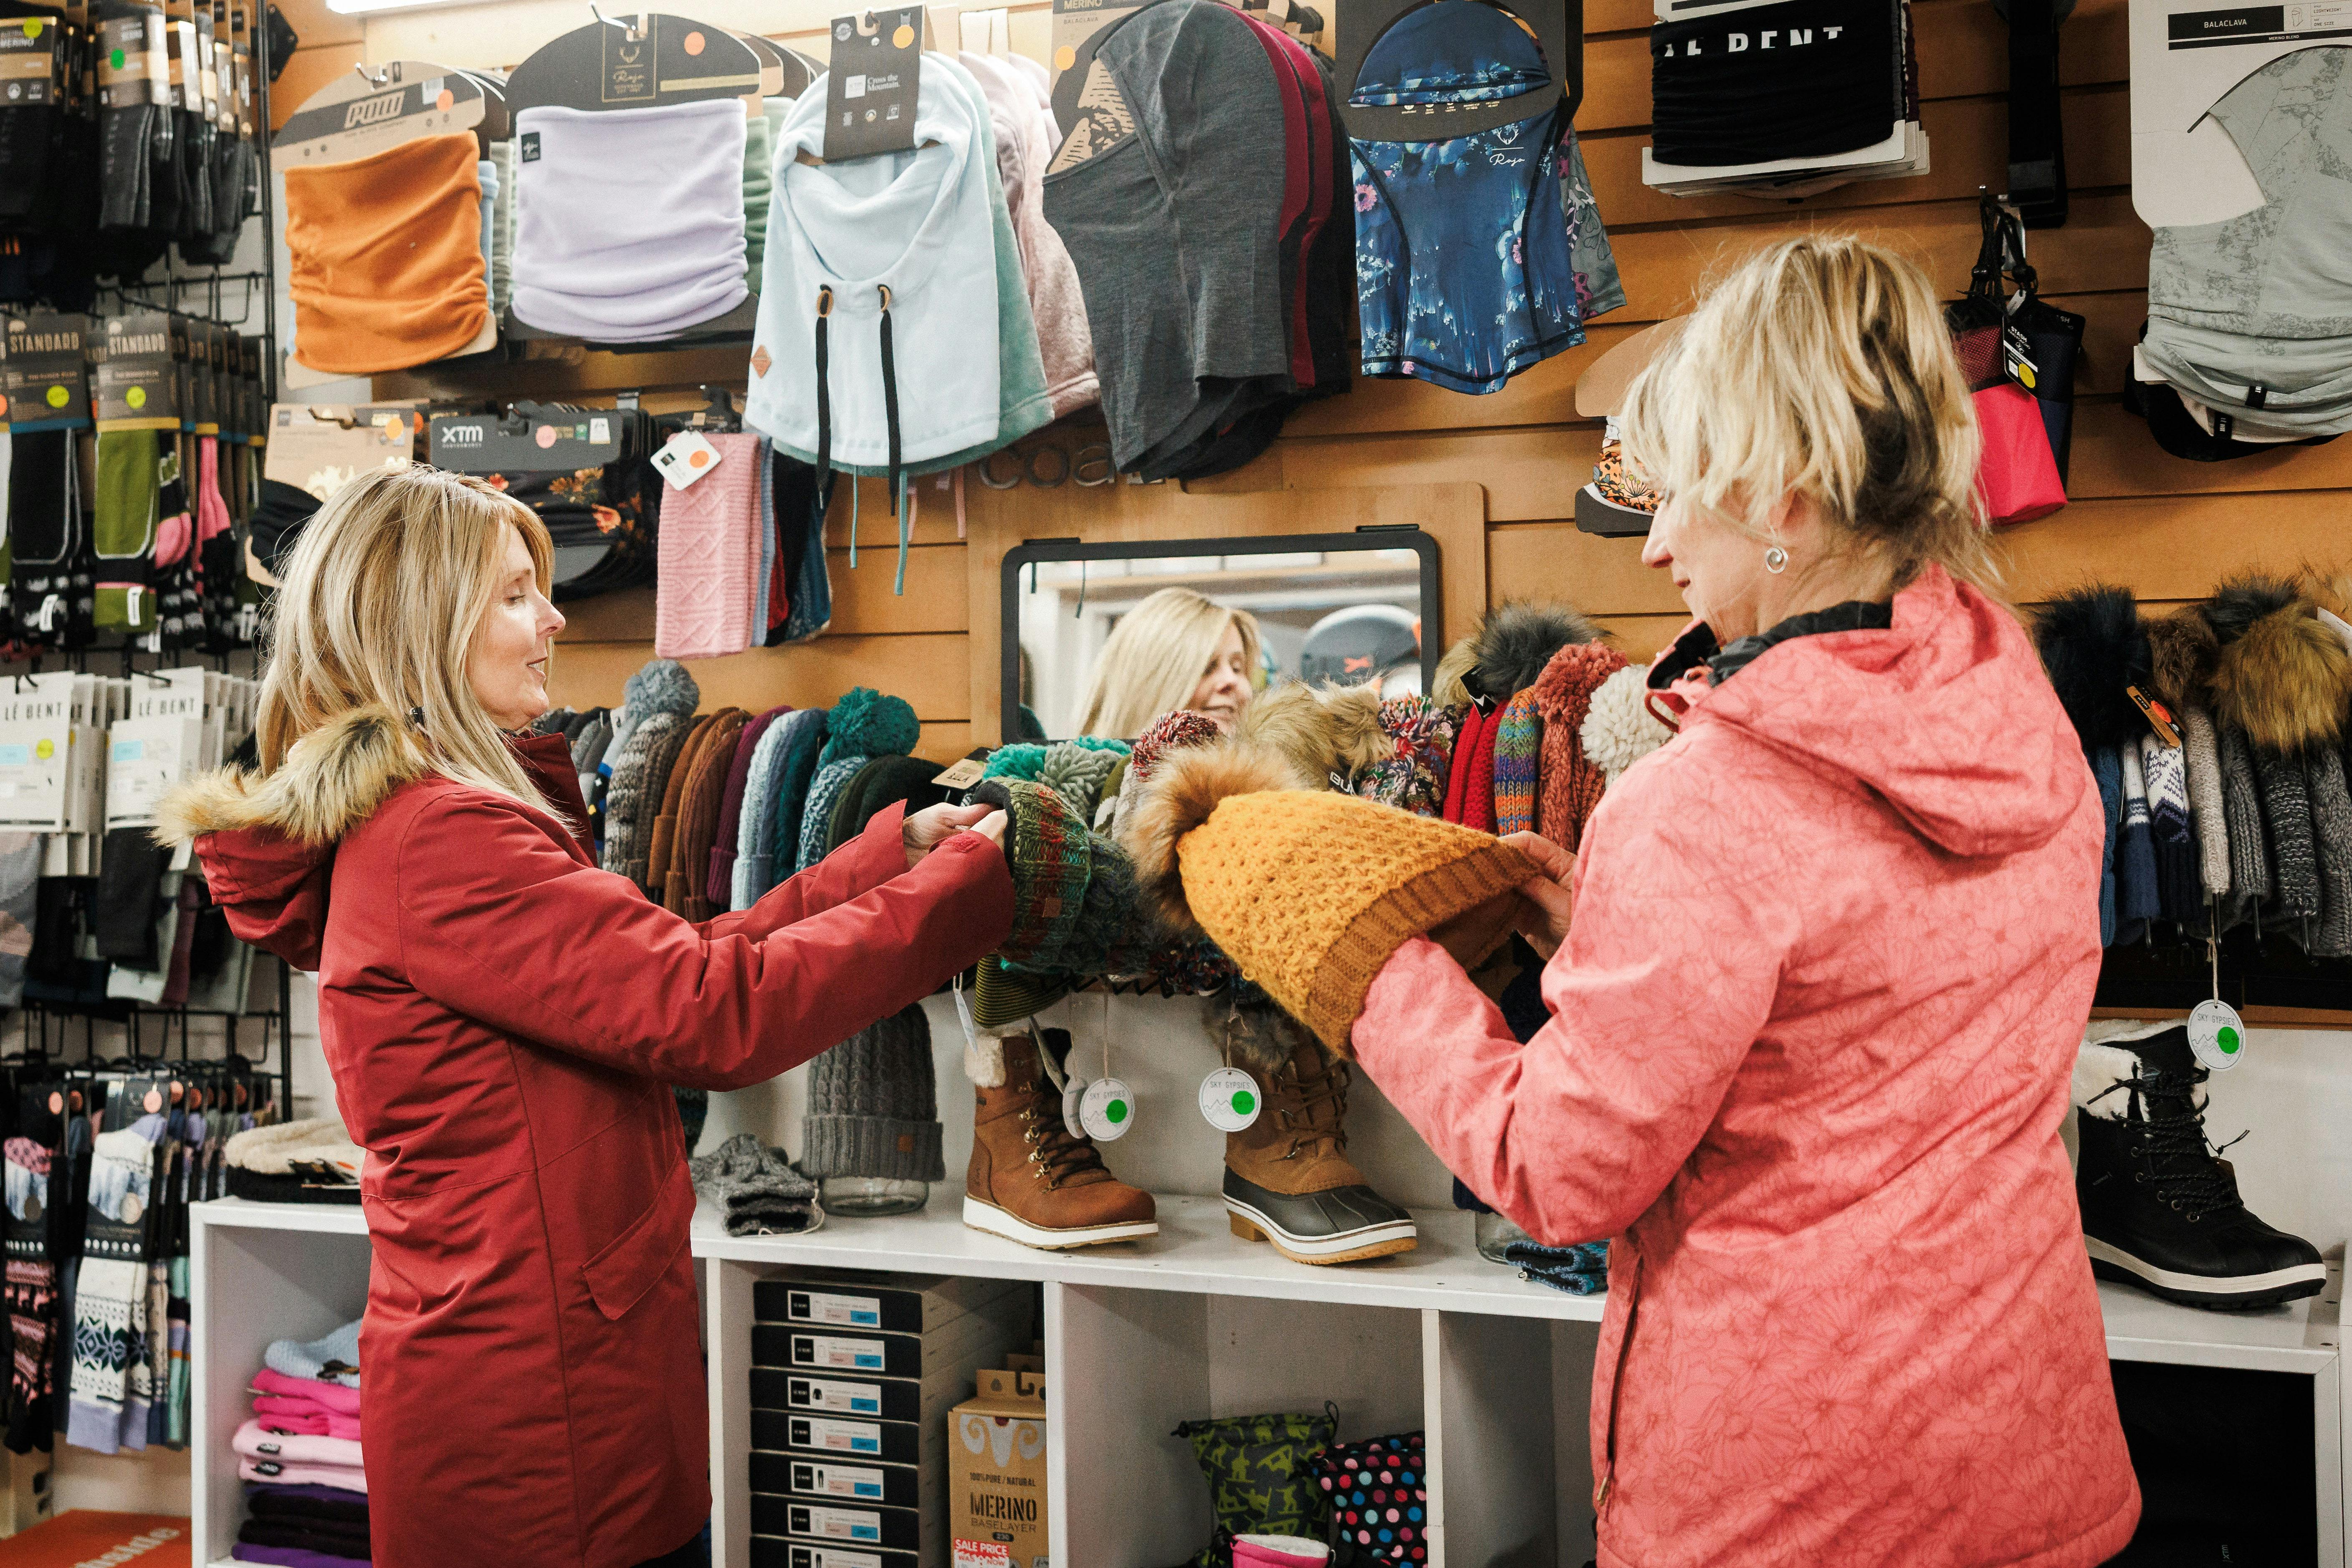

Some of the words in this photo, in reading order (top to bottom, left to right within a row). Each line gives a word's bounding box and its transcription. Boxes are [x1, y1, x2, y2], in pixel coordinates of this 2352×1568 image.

[2204, 19, 2247, 28] BALACLAVA
[2198, 1013, 2208, 1022] SKY
[2212, 1015, 2235, 1026] GYPSIES
[970, 1492, 1037, 1522] MERINO
[971, 1517, 1037, 1533] BASELAYER
[955, 1539, 978, 1552] SALE
[980, 1542, 1007, 1555] PRICE
